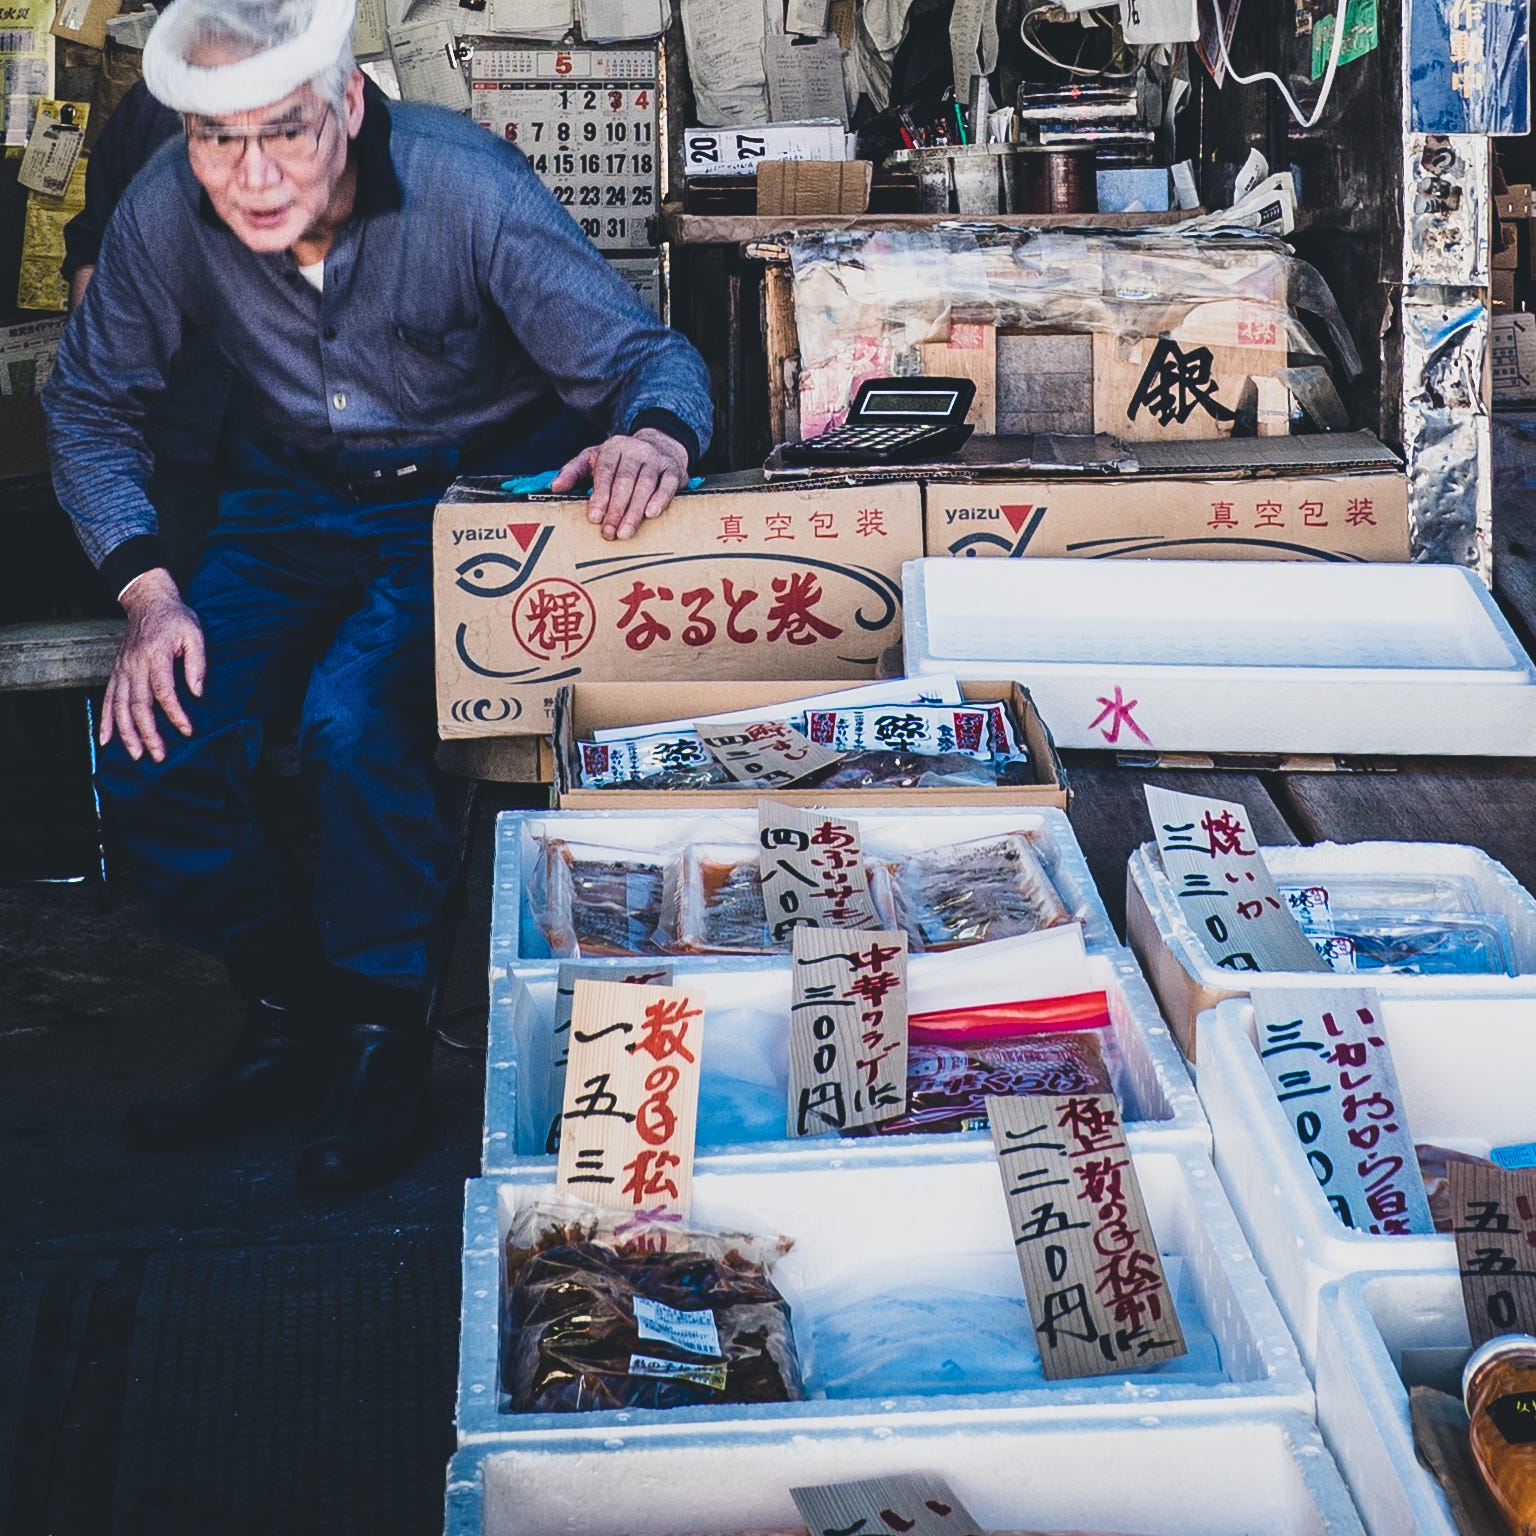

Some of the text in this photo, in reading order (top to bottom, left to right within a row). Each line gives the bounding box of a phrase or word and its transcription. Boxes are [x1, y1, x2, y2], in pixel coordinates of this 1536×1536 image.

[556, 52, 573, 76] 5
[583, 90, 597, 110] 2
[634, 90, 650, 110] 4
[531, 122, 544, 142] 7
[557, 122, 571, 142] 8
[583, 122, 597, 142] 9
[606, 122, 627, 142] 10
[633, 122, 652, 142] 11
[690, 134, 765, 163] 20 27
[528, 153, 653, 174] 14 15 16 17 18
[554, 185, 653, 206] 22 23 24 25
[580, 217, 627, 238] 30 31
[1126, 331, 1238, 428] 銀
[944, 505, 1002, 525] yaizu
[1206, 497, 1379, 529] 真空包装
[452, 526, 509, 546] yaizu
[716, 508, 888, 544] 真空包装
[524, 571, 844, 654] 輝 なると巻
[1087, 684, 1153, 746] 水
[1201, 809, 1282, 922] 焼いか
